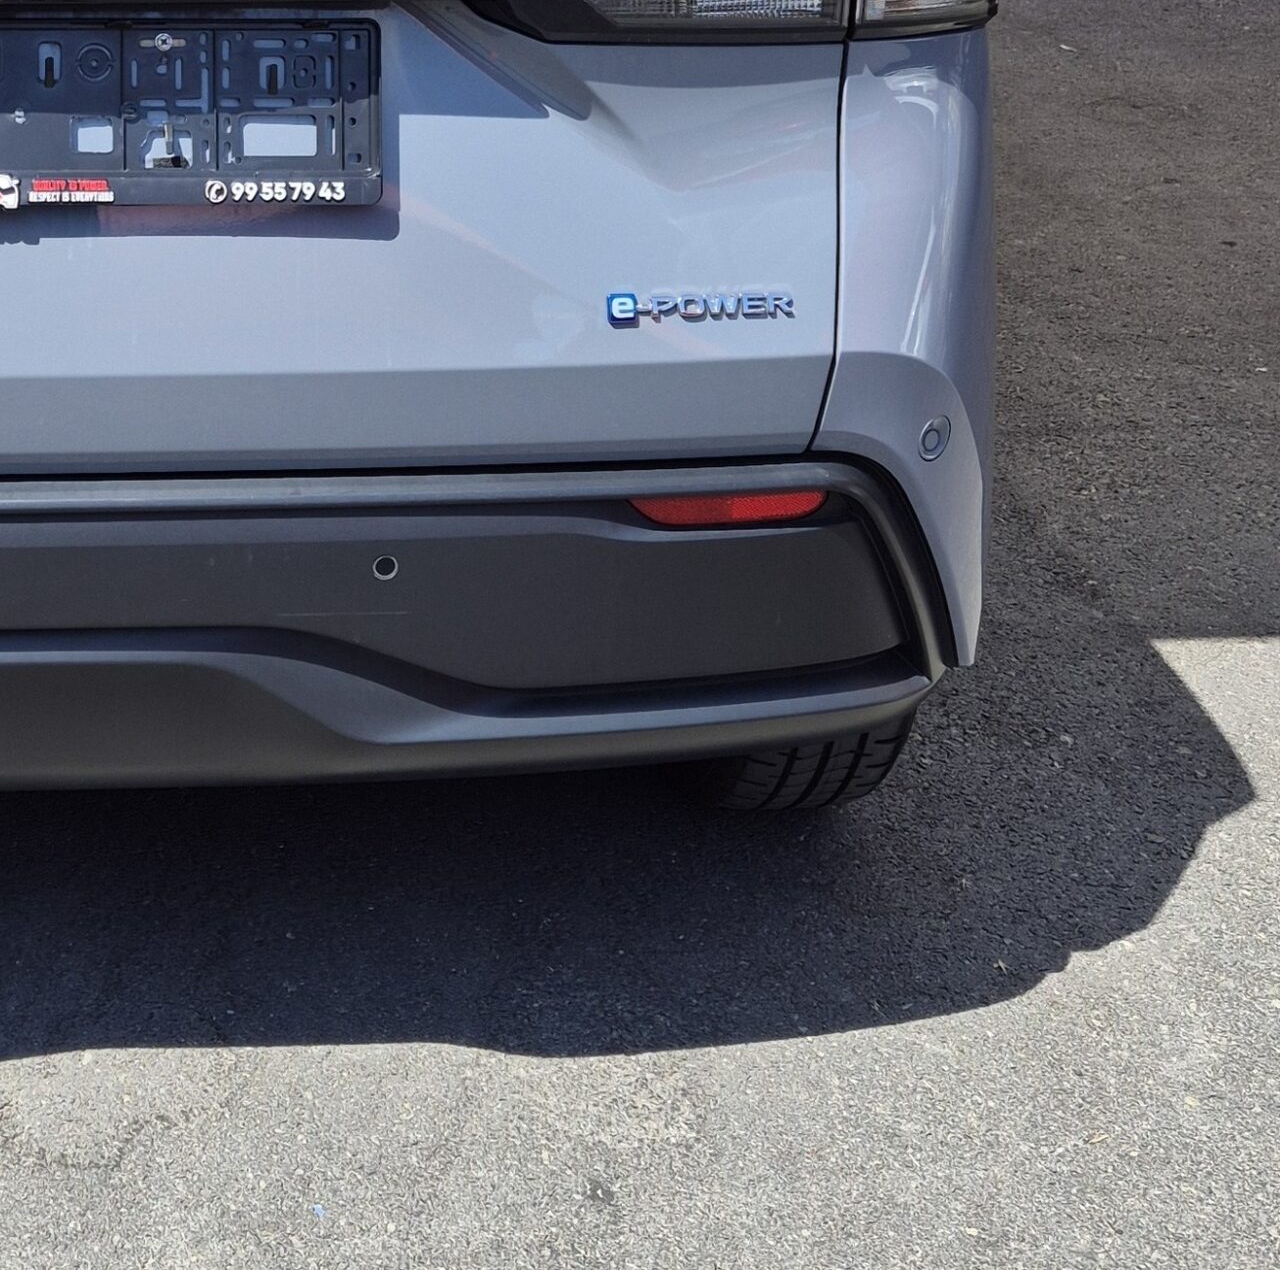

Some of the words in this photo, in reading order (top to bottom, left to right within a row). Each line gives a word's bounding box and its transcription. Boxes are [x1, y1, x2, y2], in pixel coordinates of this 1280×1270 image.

[28, 191, 60, 202] RESPECT
[62, 191, 70, 202] IS
[608, 292, 796, 325] e-POWER
